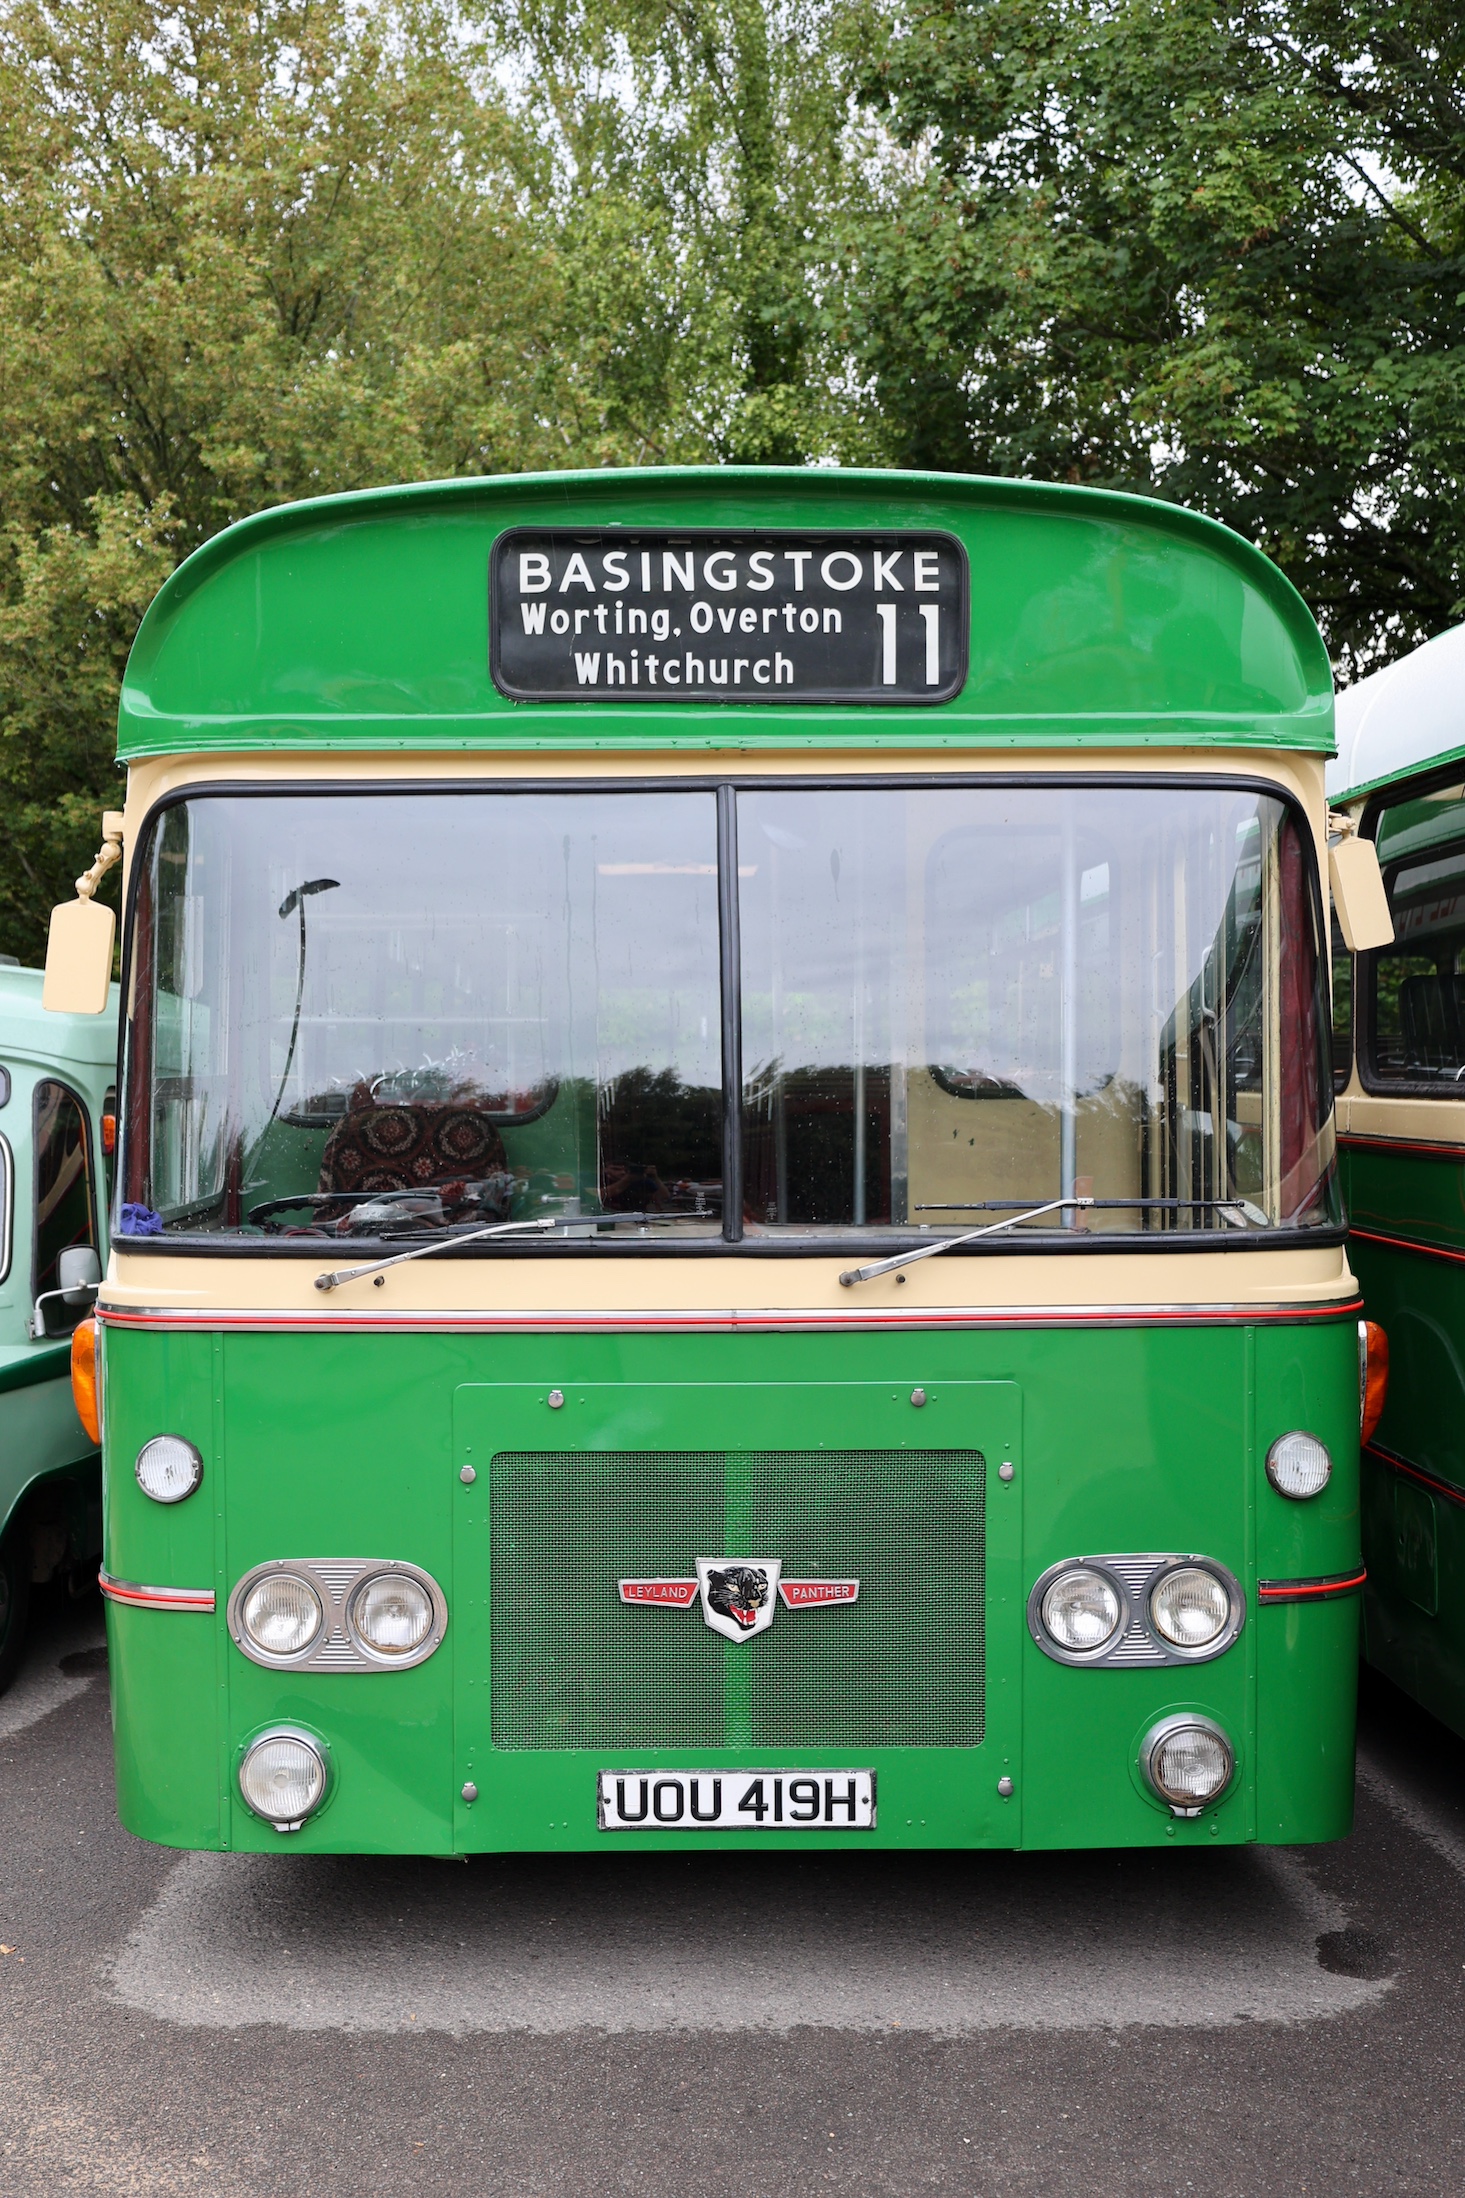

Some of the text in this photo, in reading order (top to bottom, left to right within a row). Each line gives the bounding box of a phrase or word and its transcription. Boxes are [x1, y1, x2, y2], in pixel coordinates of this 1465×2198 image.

[518, 551, 940, 594] BASINGSTOKE
[520, 600, 842, 641] Worting, Overton
[876, 604, 940, 685] 11
[574, 649, 795, 685] Whitchurch
[628, 1586, 850, 1599] LEYLAND PANTHER
[616, 1778, 856, 1822] UOU 419H
